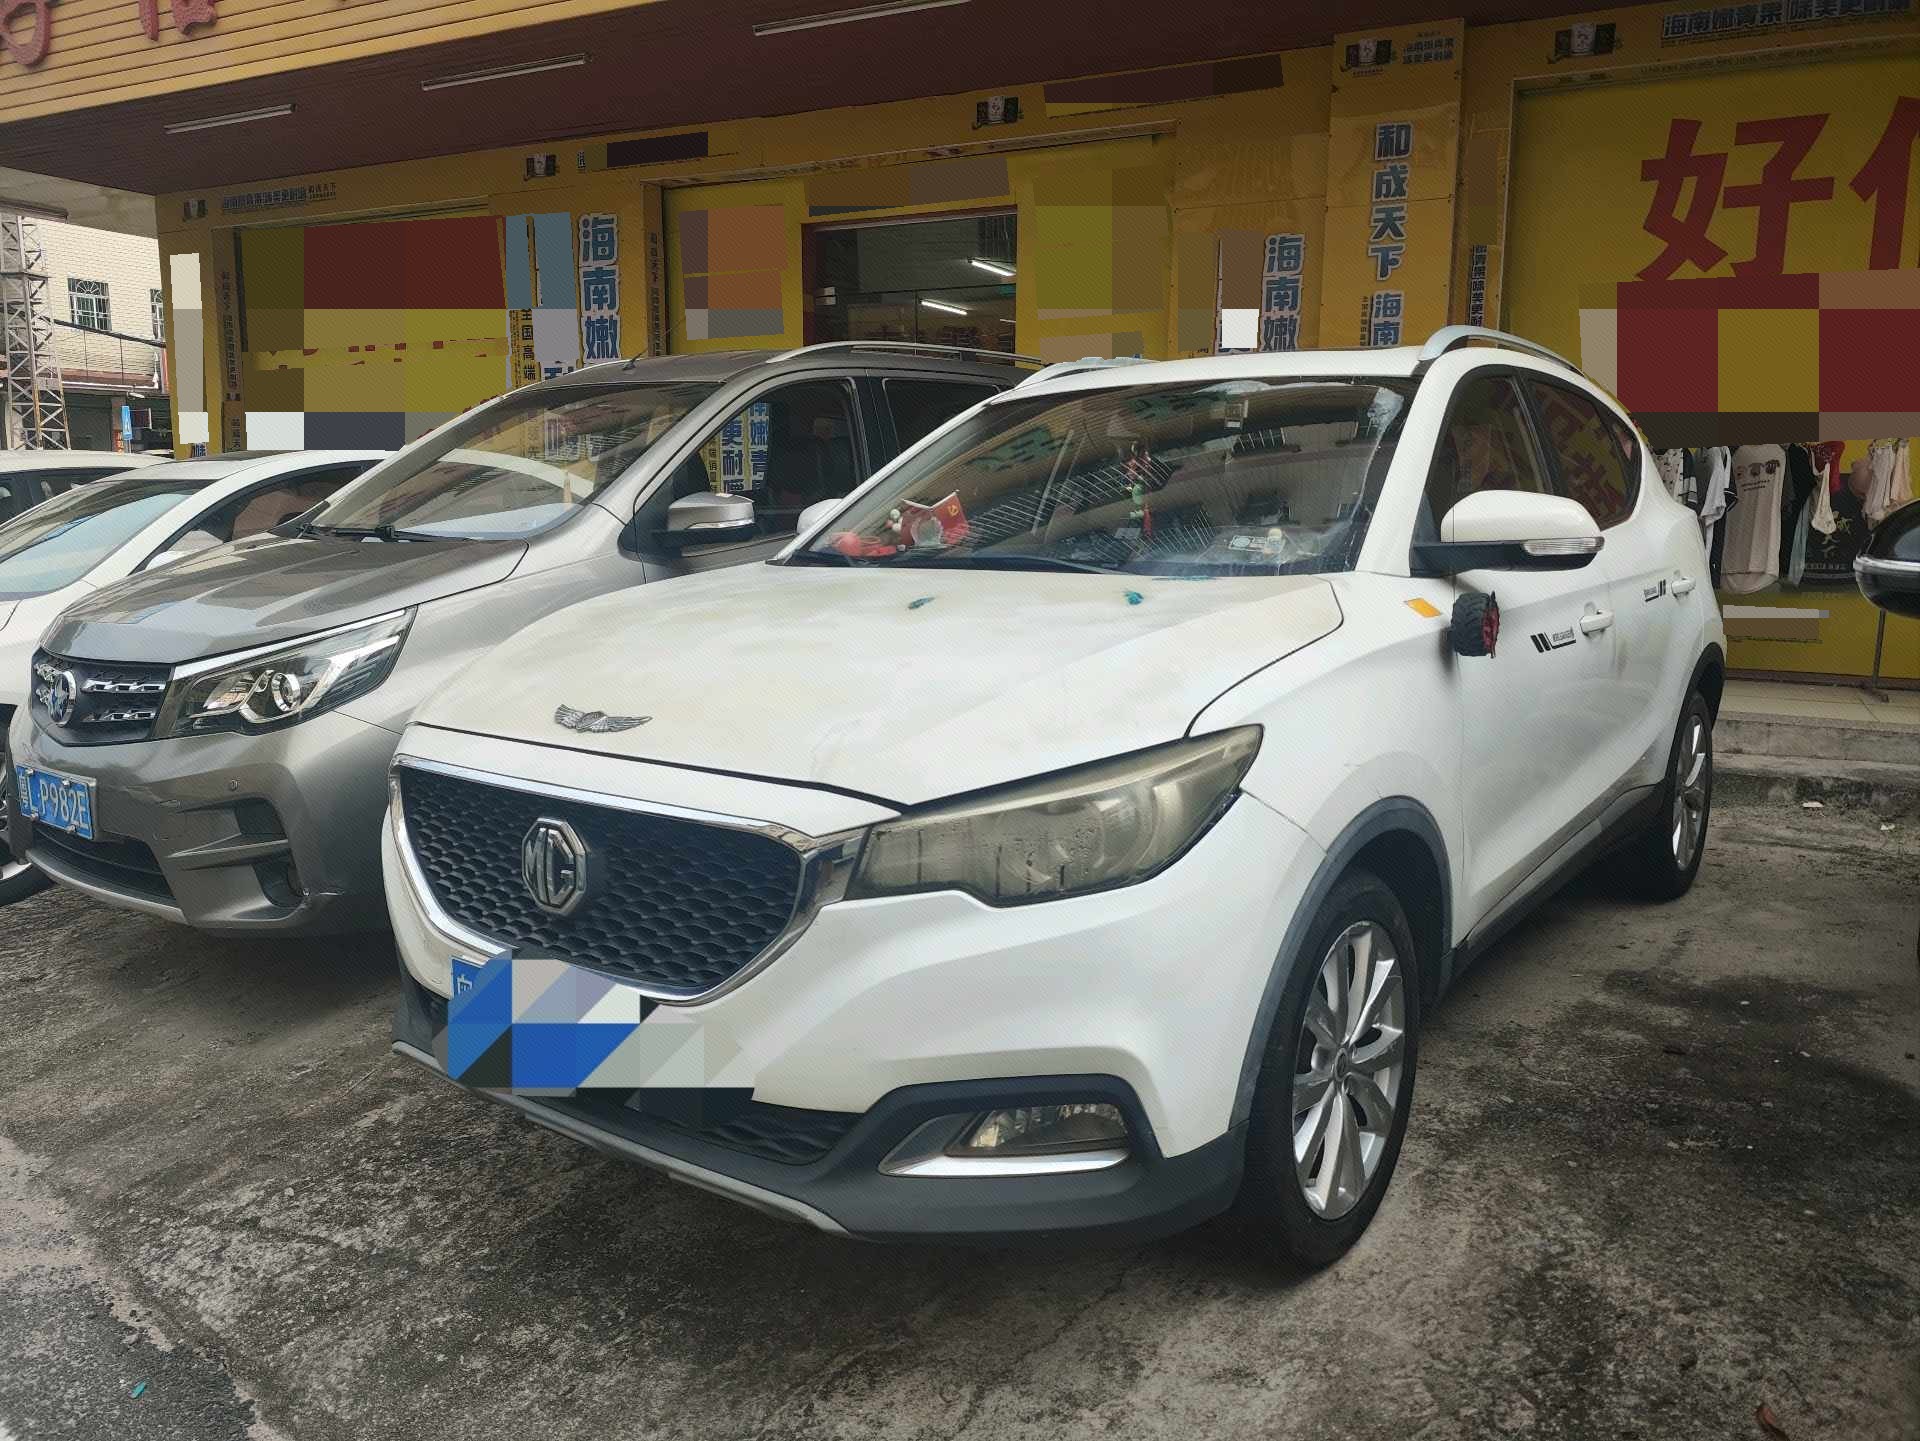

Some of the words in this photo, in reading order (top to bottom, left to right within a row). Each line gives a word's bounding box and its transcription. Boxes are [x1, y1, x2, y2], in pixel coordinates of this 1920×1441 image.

[1368, 124, 1411, 279] 和成天下
[1636, 96, 1920, 281] 好
[582, 216, 619, 359] 海南嫩
[1263, 235, 1302, 354] 海南嫩
[1373, 293, 1401, 345] 海南
[525, 827, 575, 906] MG
